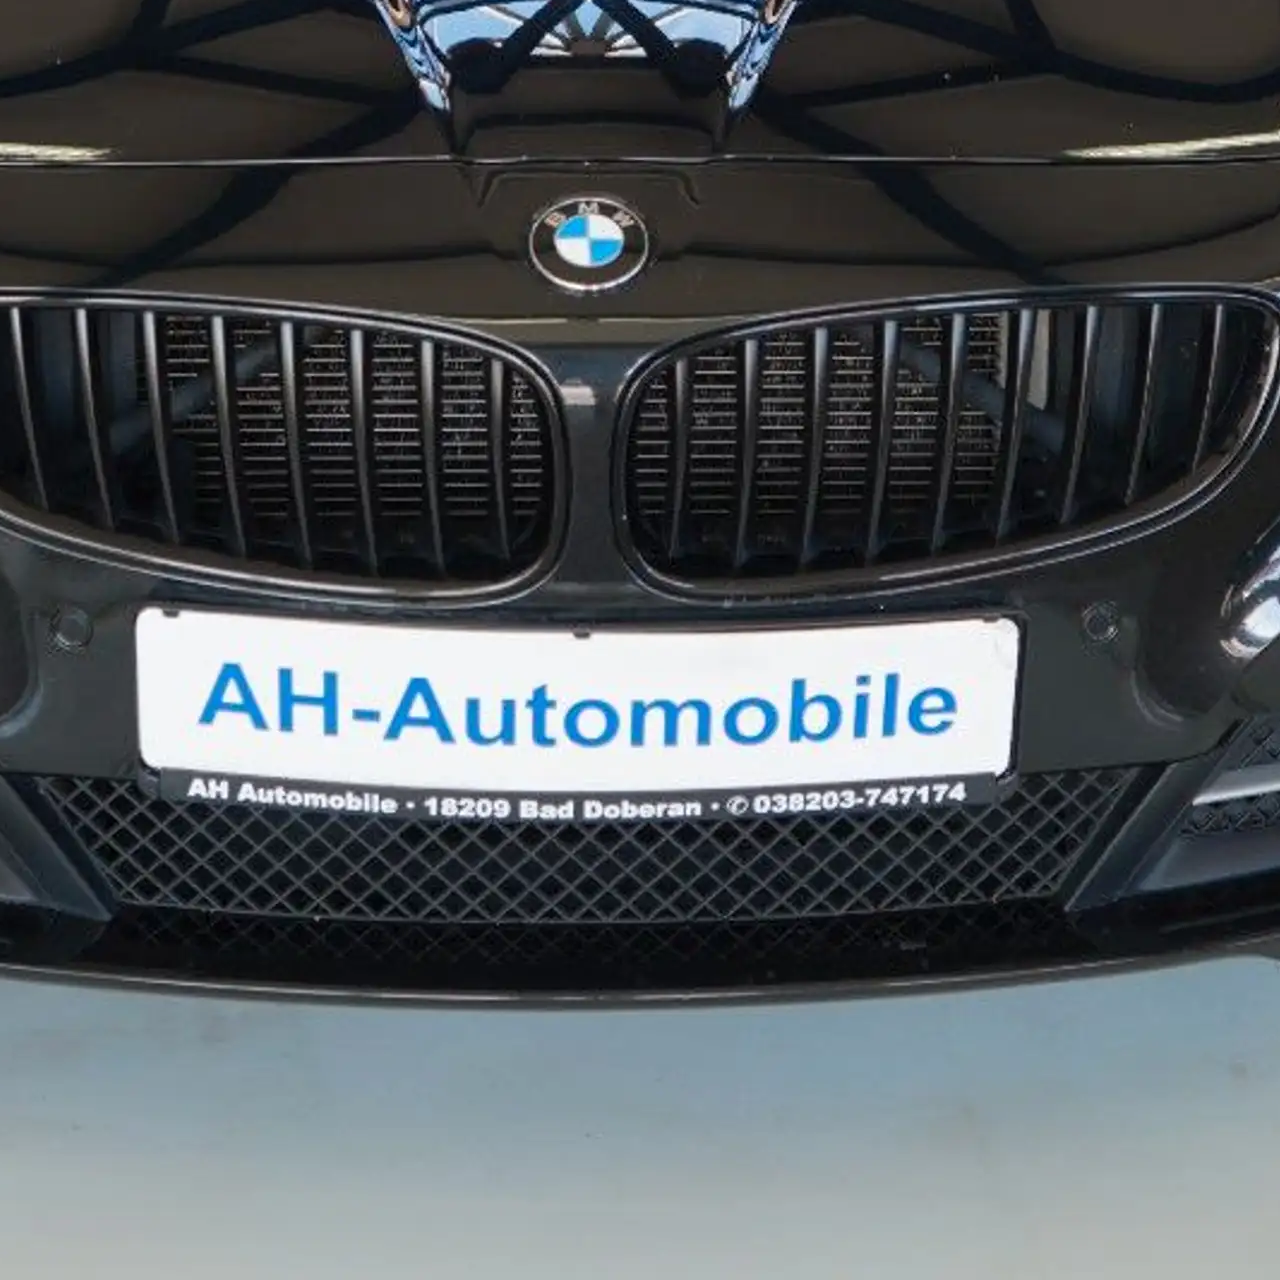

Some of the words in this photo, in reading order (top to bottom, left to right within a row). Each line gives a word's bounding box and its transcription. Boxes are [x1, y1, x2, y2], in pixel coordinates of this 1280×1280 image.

[198, 661, 958, 748] AH-Automobile
[186, 777, 230, 800] AH
[237, 781, 399, 814] Automobile
[423, 796, 512, 819] 18209
[519, 799, 576, 820] Bad
[583, 799, 703, 820] Doberan
[752, 781, 967, 815] 038203-747174
